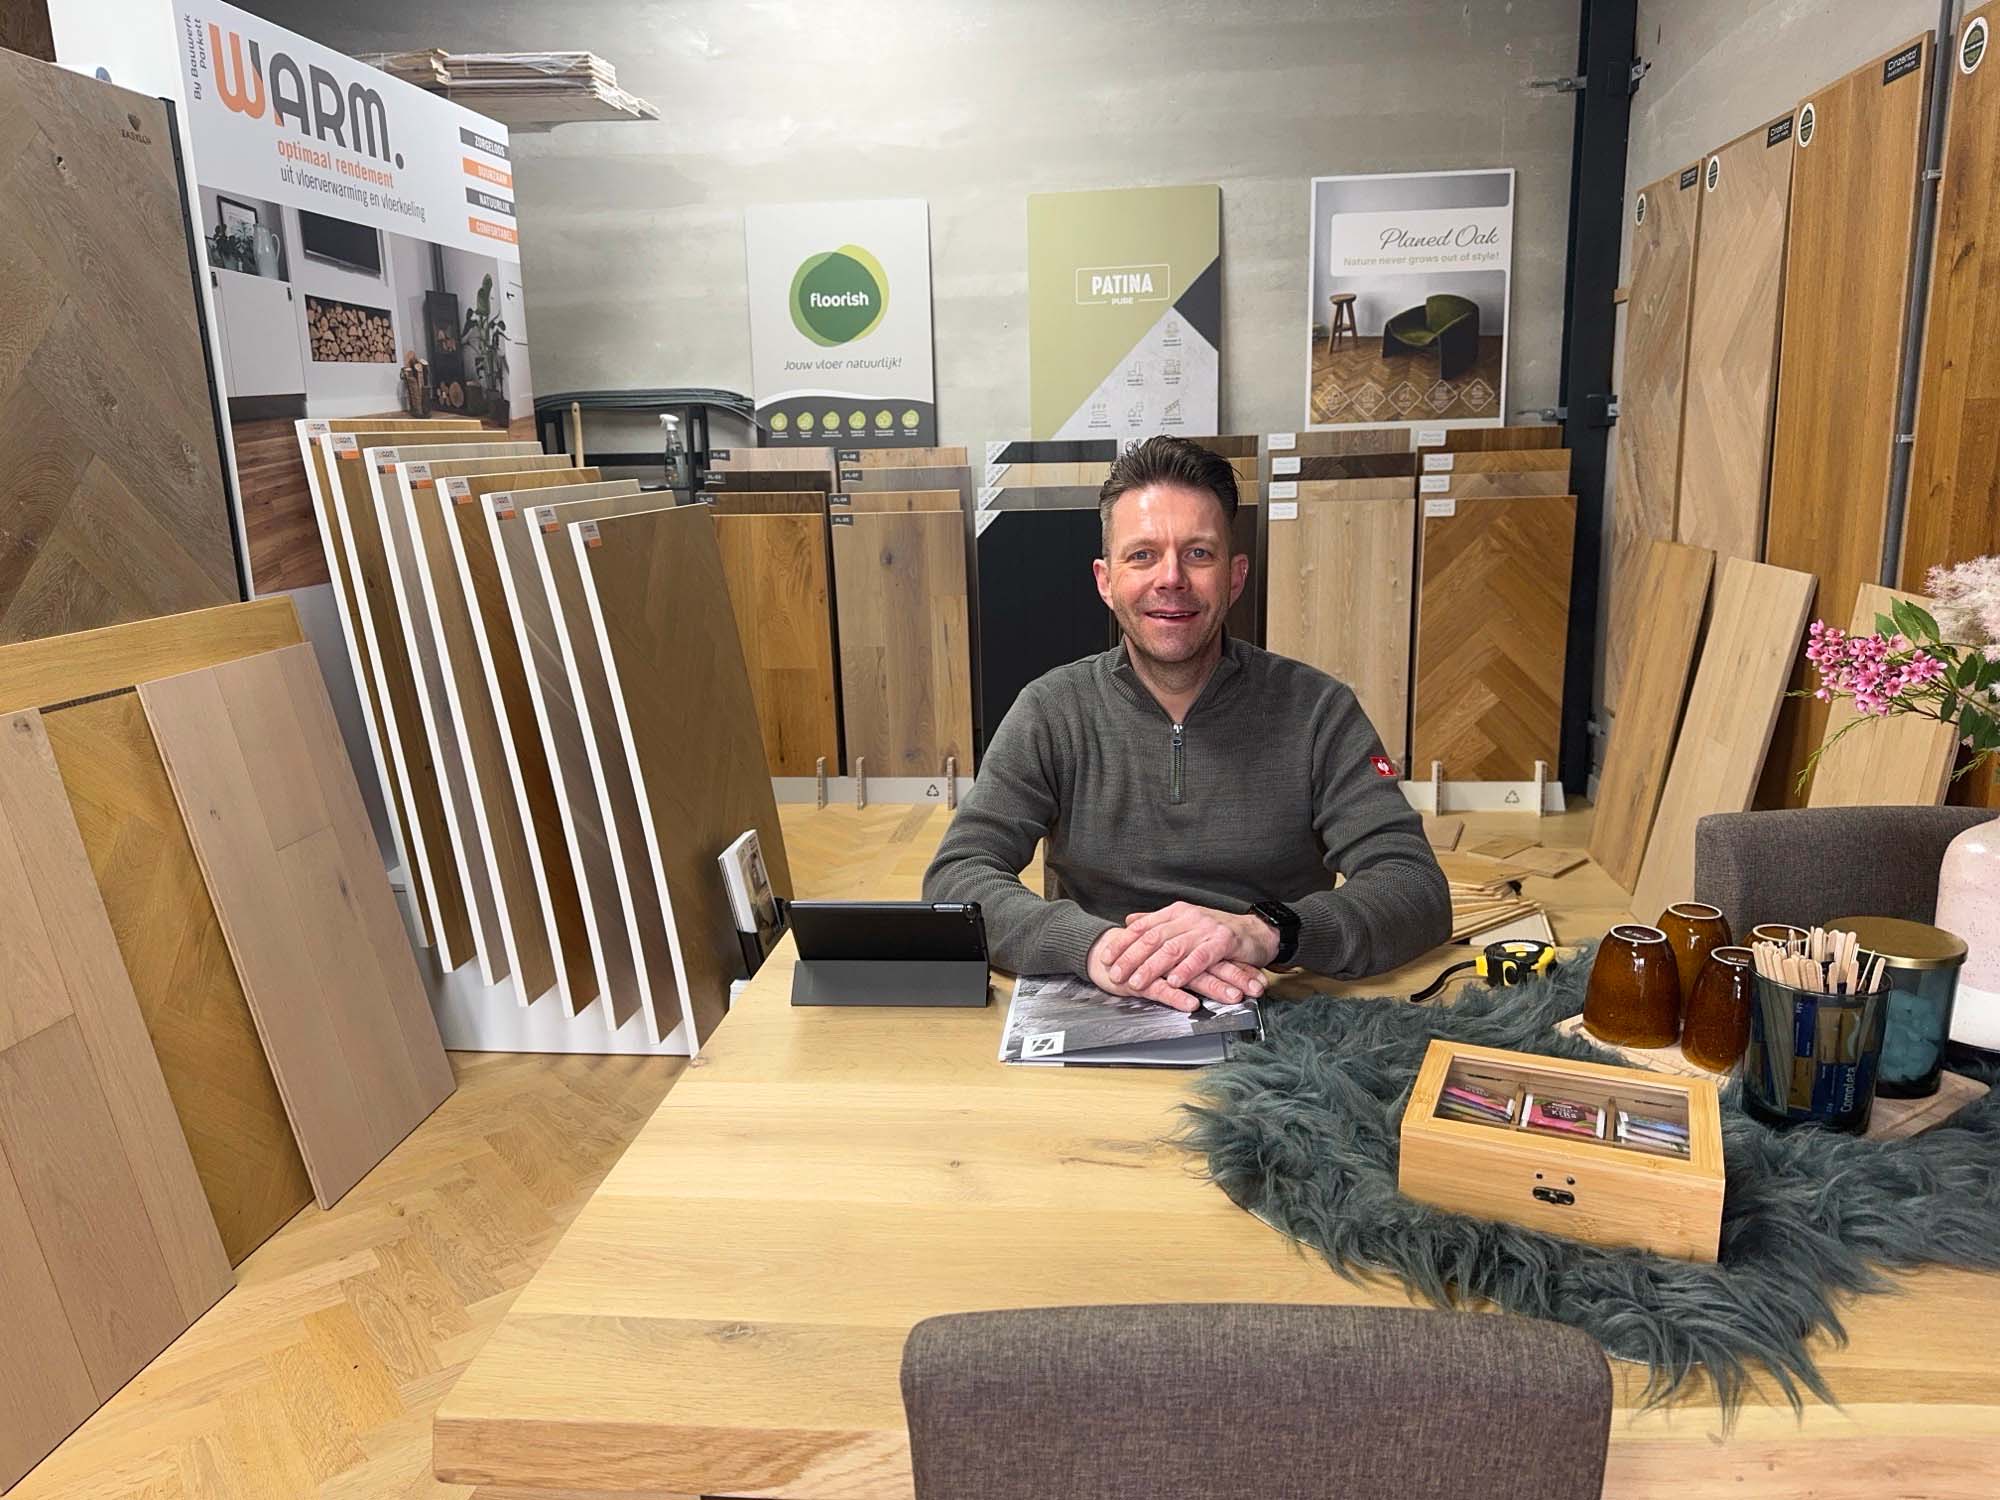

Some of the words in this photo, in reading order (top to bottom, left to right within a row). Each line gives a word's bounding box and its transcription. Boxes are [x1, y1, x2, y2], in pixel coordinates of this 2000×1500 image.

[184, 14, 200, 81] Bauwerk
[193, 84, 203, 101] By
[475, 135, 505, 157] ZORGELOOS
[278, 140, 332, 170] optimaal
[335, 158, 394, 189] rendement
[280, 164, 294, 184] uit
[296, 169, 369, 208] vloerverwarming
[369, 192, 380, 207] en
[381, 193, 426, 223] vloerkoeling
[479, 192, 511, 214] NATUURLIJK
[1379, 227, 1450, 250] Planed
[1455, 224, 1500, 248] Oak
[1343, 257, 1377, 267] Nature
[1378, 256, 1406, 265] never
[1408, 255, 1439, 266] grows
[1441, 254, 1458, 263] out
[1459, 252, 1470, 262] of
[1471, 251, 1500, 263] style!
[1092, 273, 1153, 295] PATINA
[810, 291, 869, 308] floorish
[784, 359, 812, 371] Jouw
[815, 359, 843, 370] vloer
[846, 356, 903, 371] natuurlijk!
[1840, 1066, 1857, 1113] Completa
